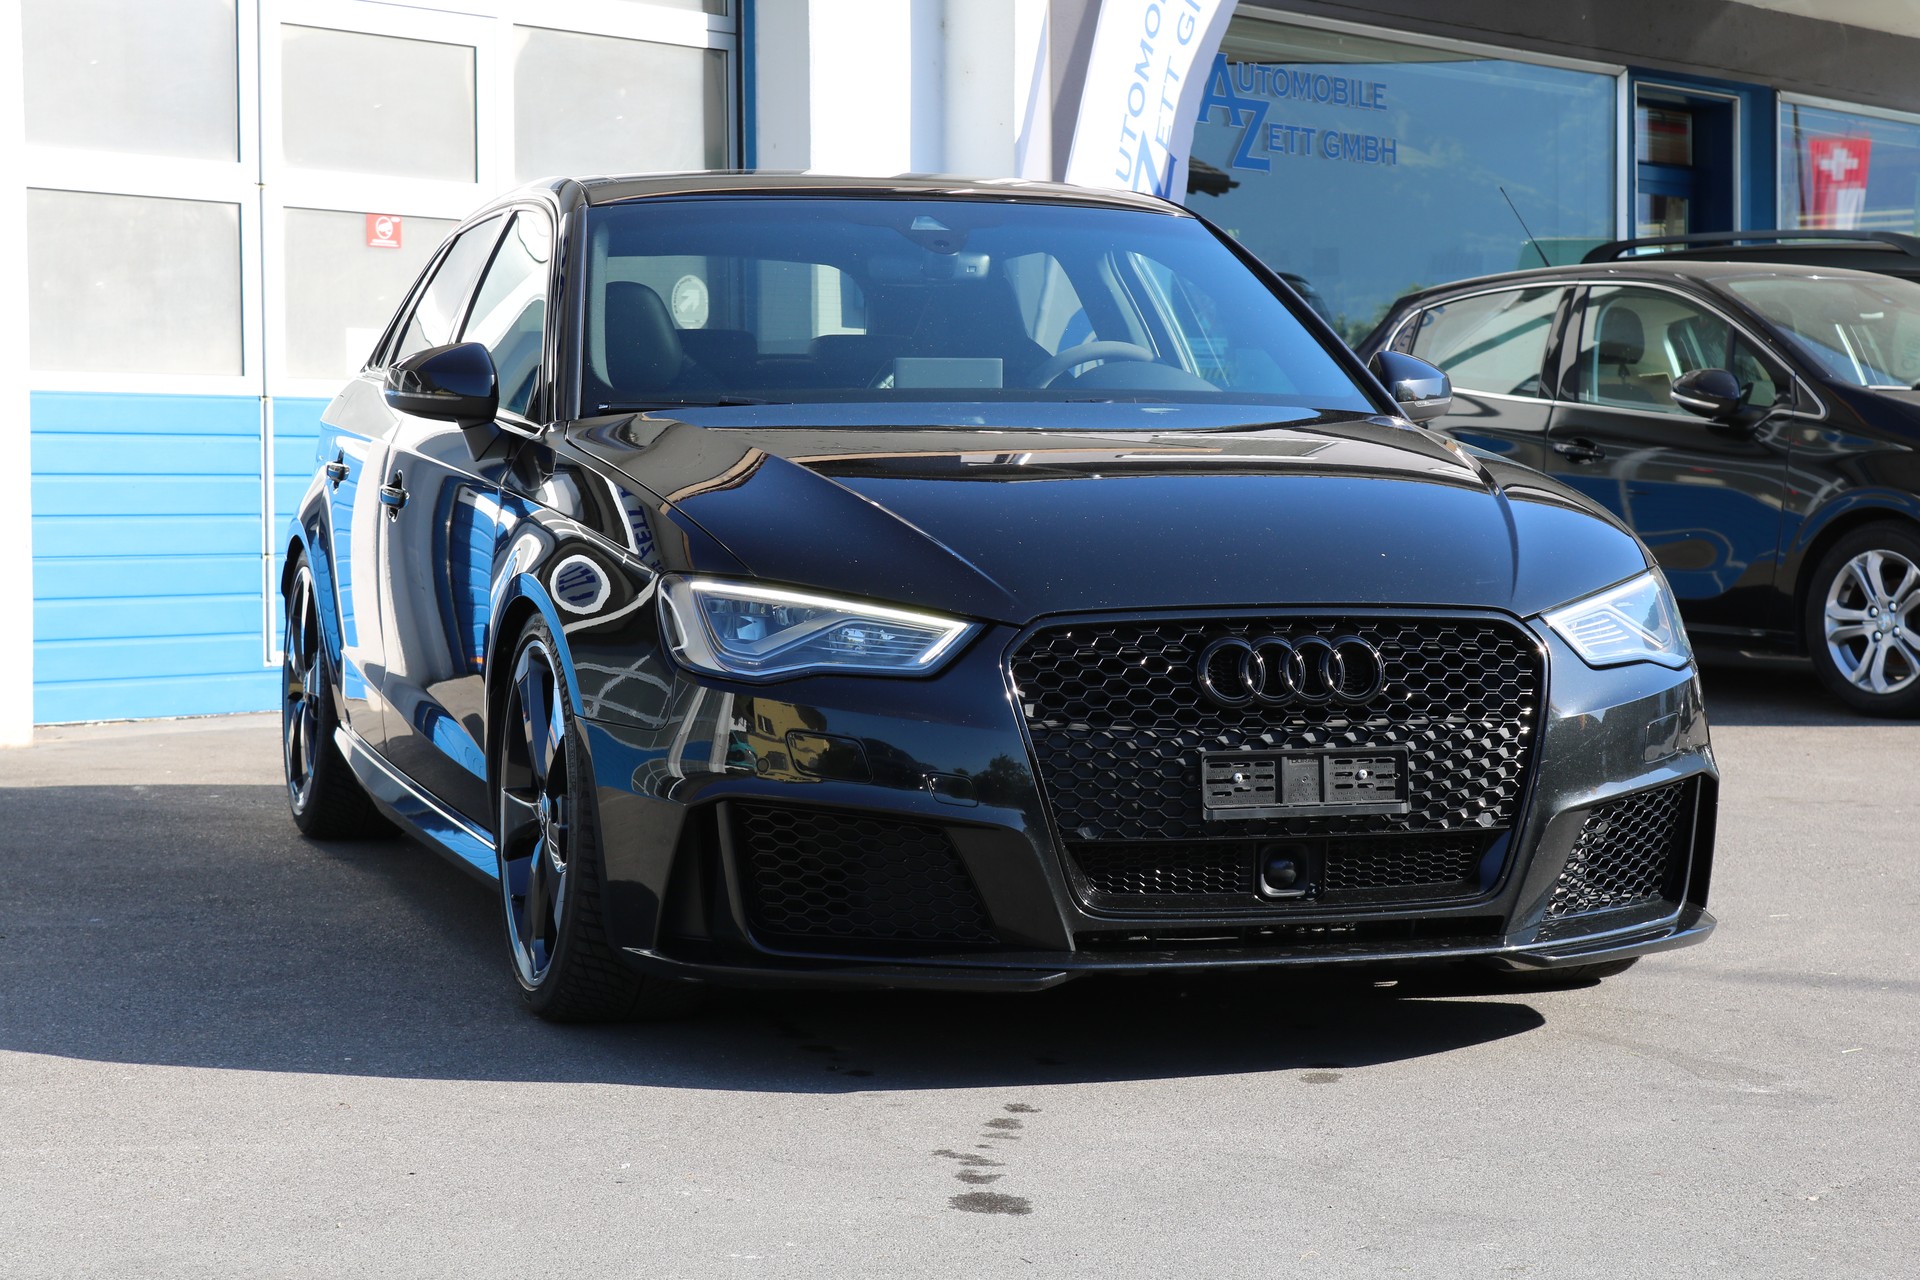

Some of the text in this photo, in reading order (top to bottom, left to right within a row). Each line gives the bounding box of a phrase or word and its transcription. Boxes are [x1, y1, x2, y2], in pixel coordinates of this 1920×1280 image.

[1197, 52, 1388, 127] AUTOMOBILE
[1231, 99, 1398, 173] ZETT GMBH
